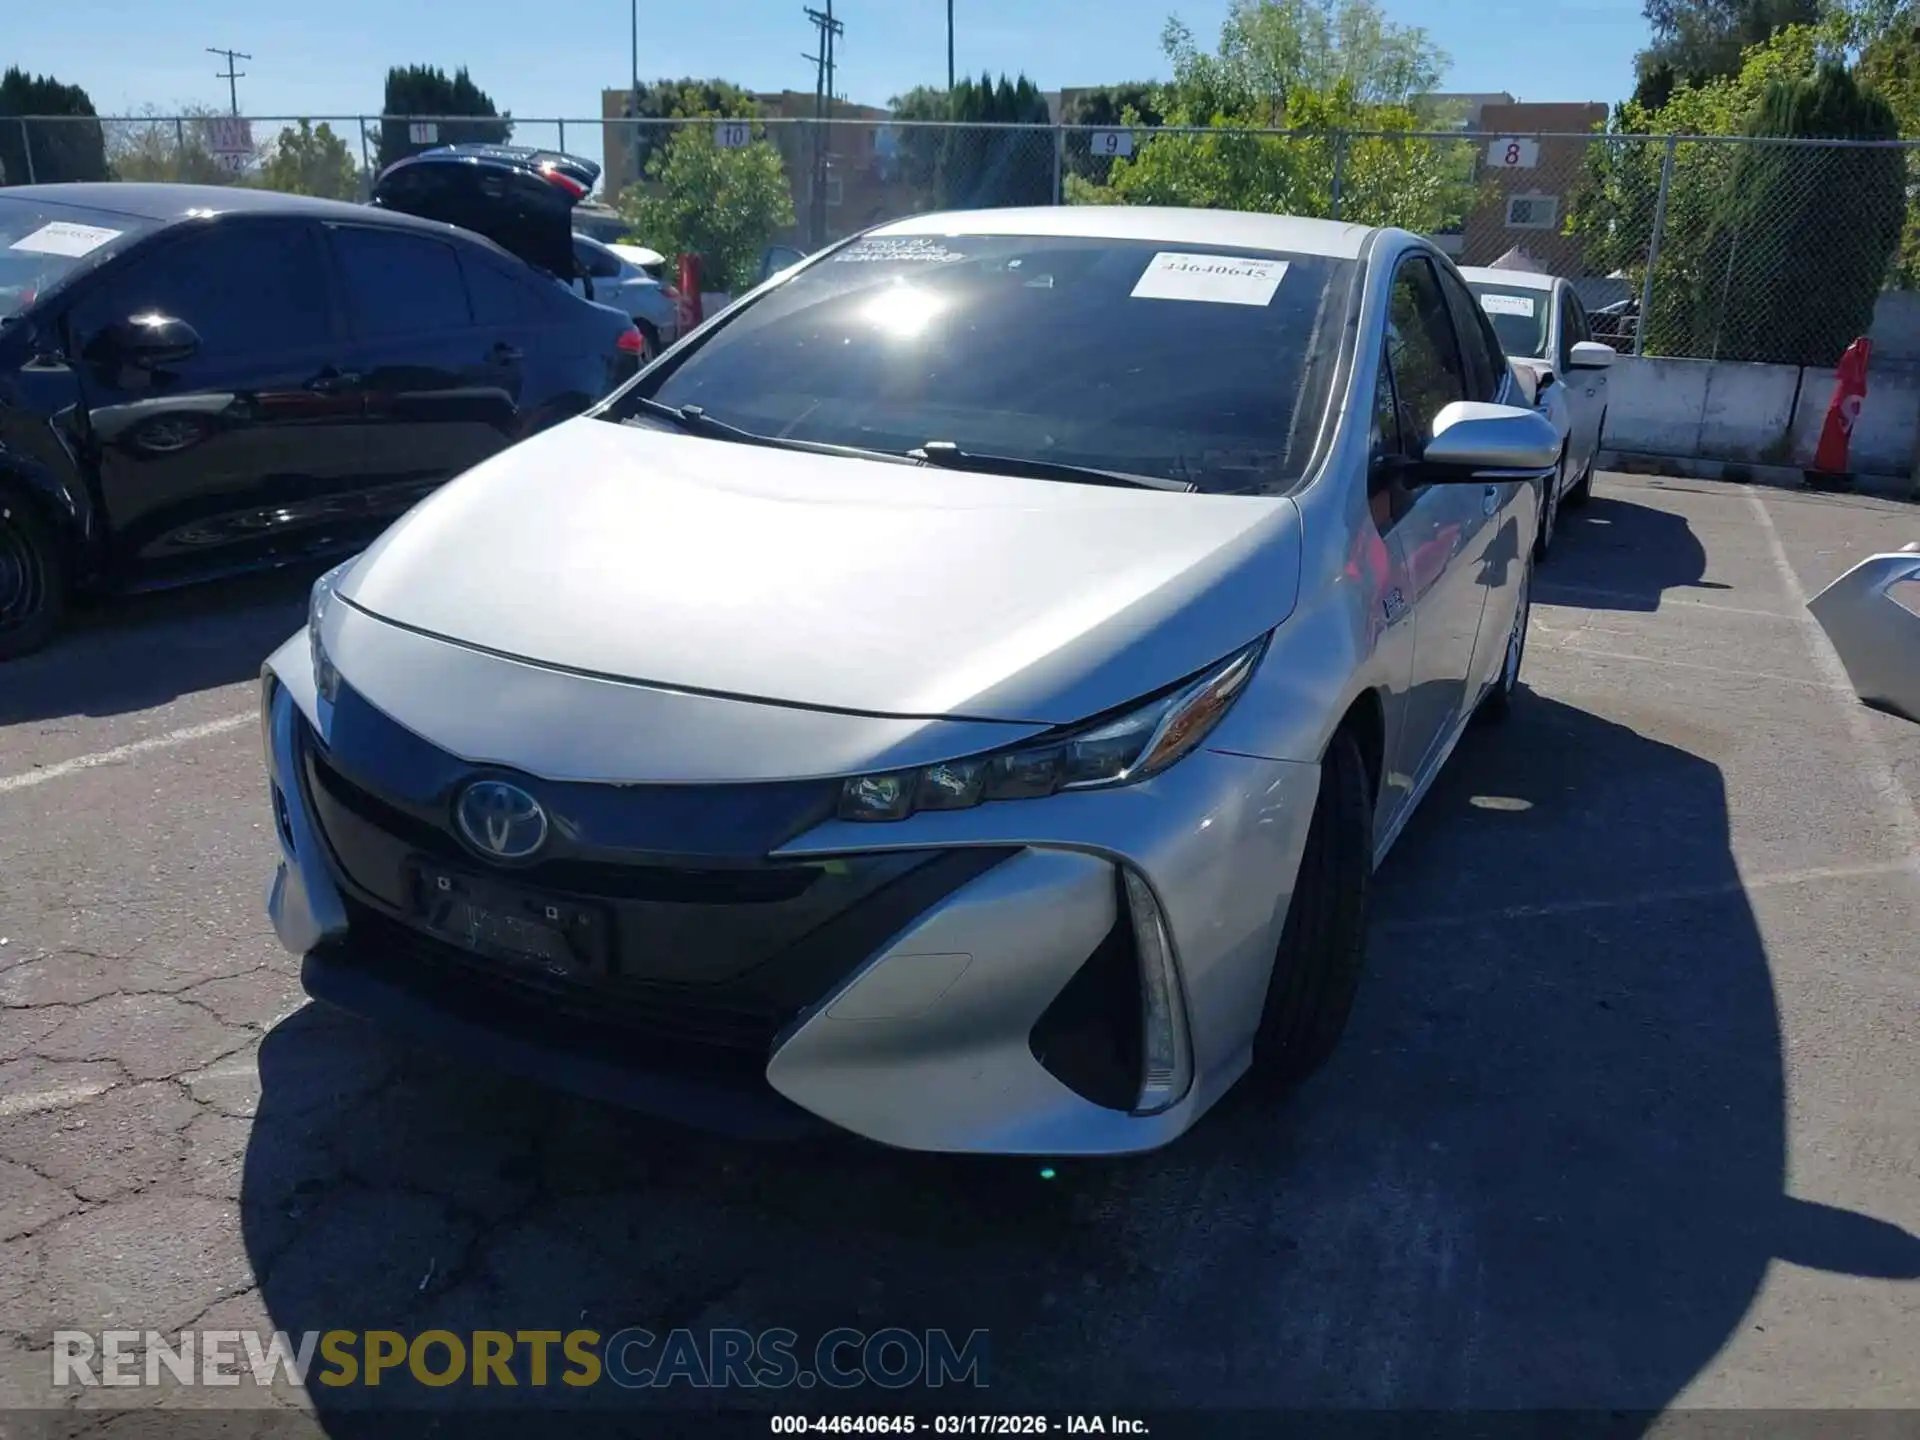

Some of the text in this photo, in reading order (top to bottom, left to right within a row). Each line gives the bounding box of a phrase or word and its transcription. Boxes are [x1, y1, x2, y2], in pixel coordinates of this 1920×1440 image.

[724, 126, 744, 146] 10
[1106, 133, 1119, 154] 9
[1504, 143, 1521, 165] 8
[1161, 262, 1268, 279] 44640645
